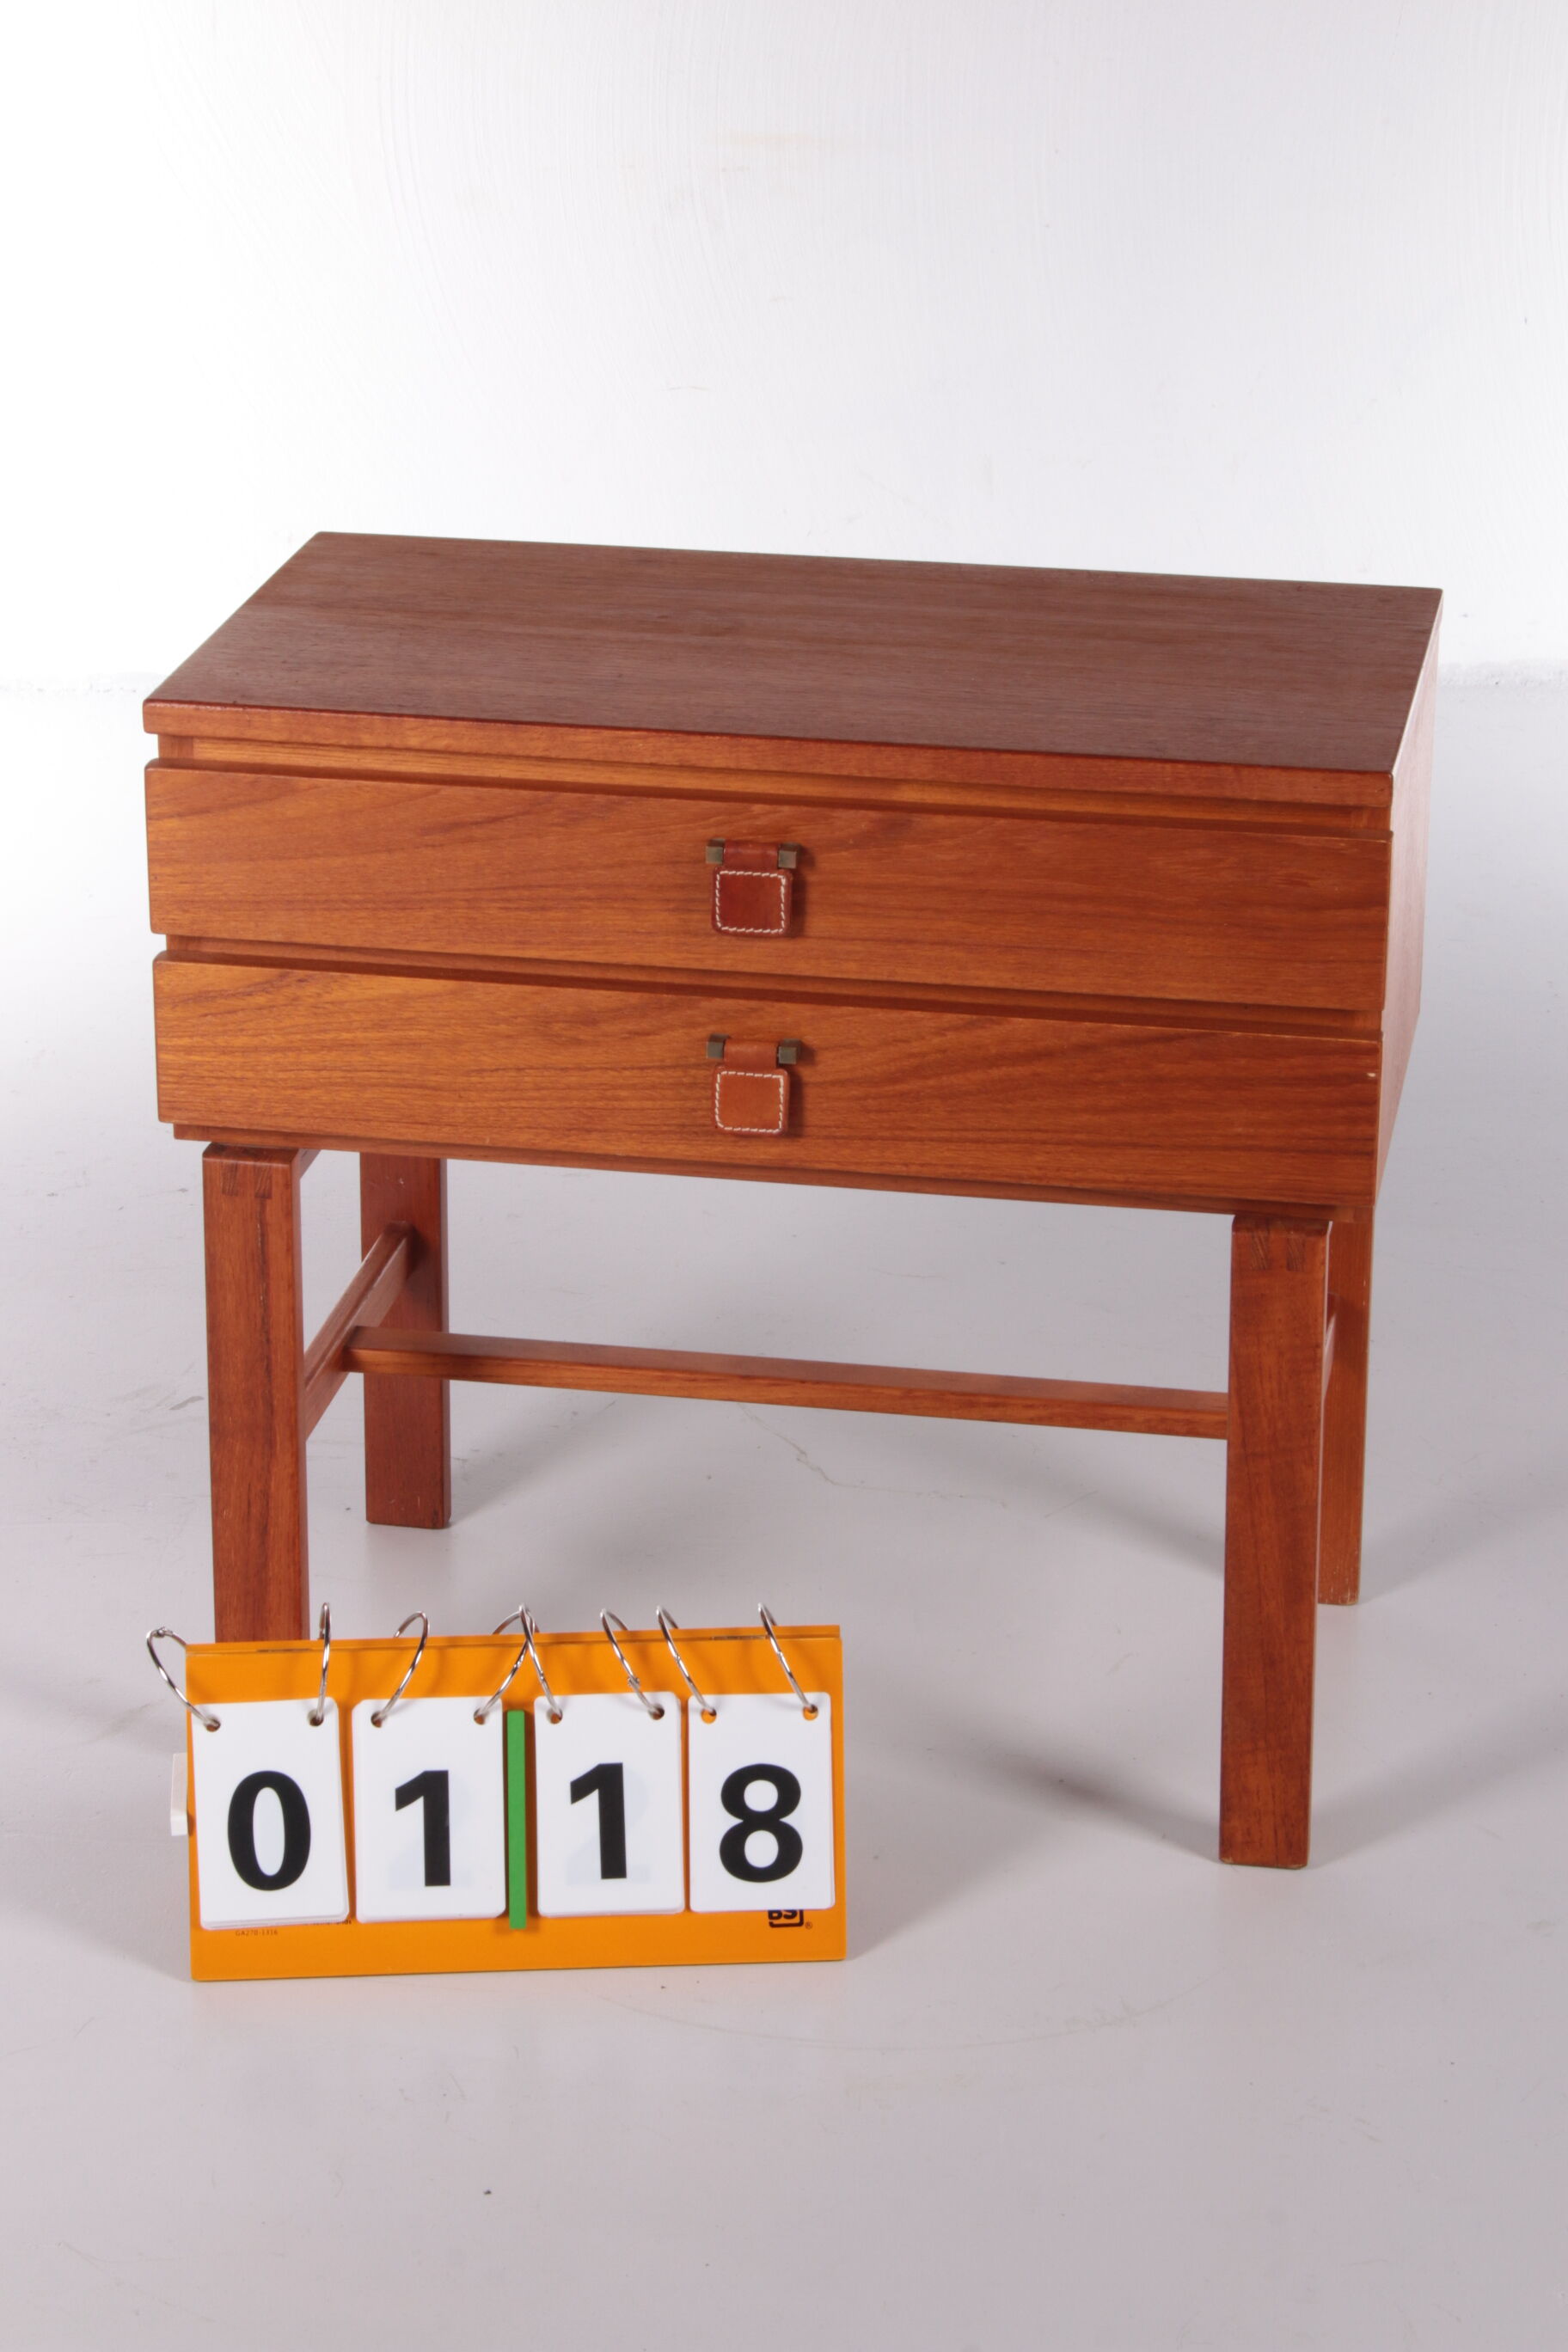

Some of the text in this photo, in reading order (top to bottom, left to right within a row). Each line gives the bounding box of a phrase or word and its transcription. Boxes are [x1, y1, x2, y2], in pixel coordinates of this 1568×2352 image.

[395, 1770, 451, 1887] 1
[570, 1762, 627, 1880] 1
[719, 1763, 803, 1883] 8
